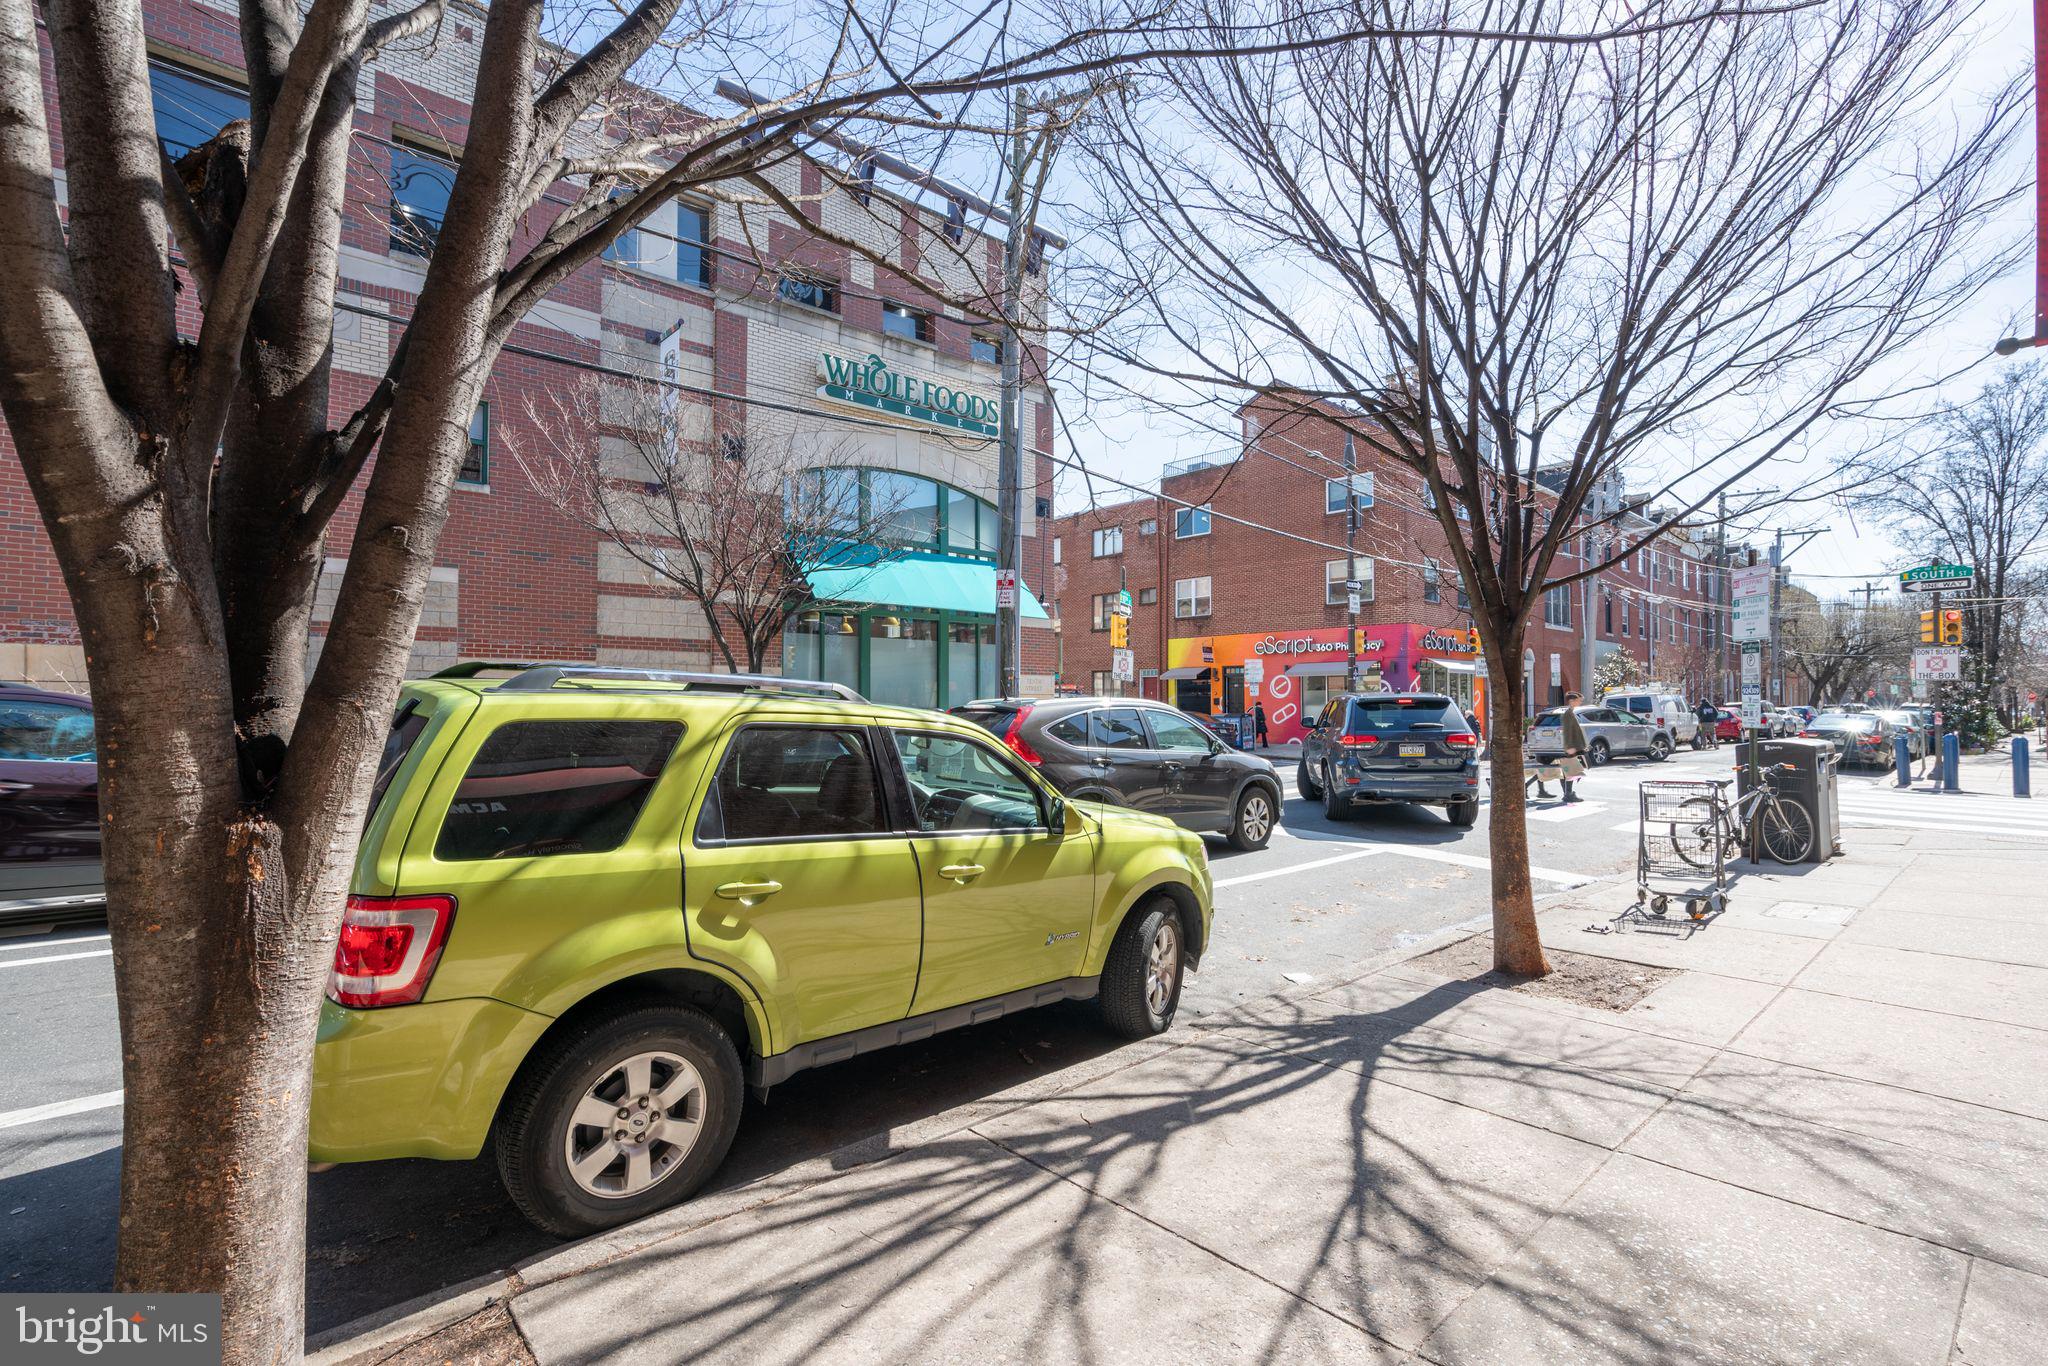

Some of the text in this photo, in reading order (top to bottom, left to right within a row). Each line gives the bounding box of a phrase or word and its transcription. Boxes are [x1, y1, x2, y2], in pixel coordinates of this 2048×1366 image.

[822, 353, 999, 424] WHOLE FOODS
[845, 390, 988, 433] MARKET
[1911, 570, 1955, 580] SOUTH
[1254, 635, 1314, 657] eScript
[1316, 642, 1333, 652] 360
[1424, 630, 1457, 656] eScript
